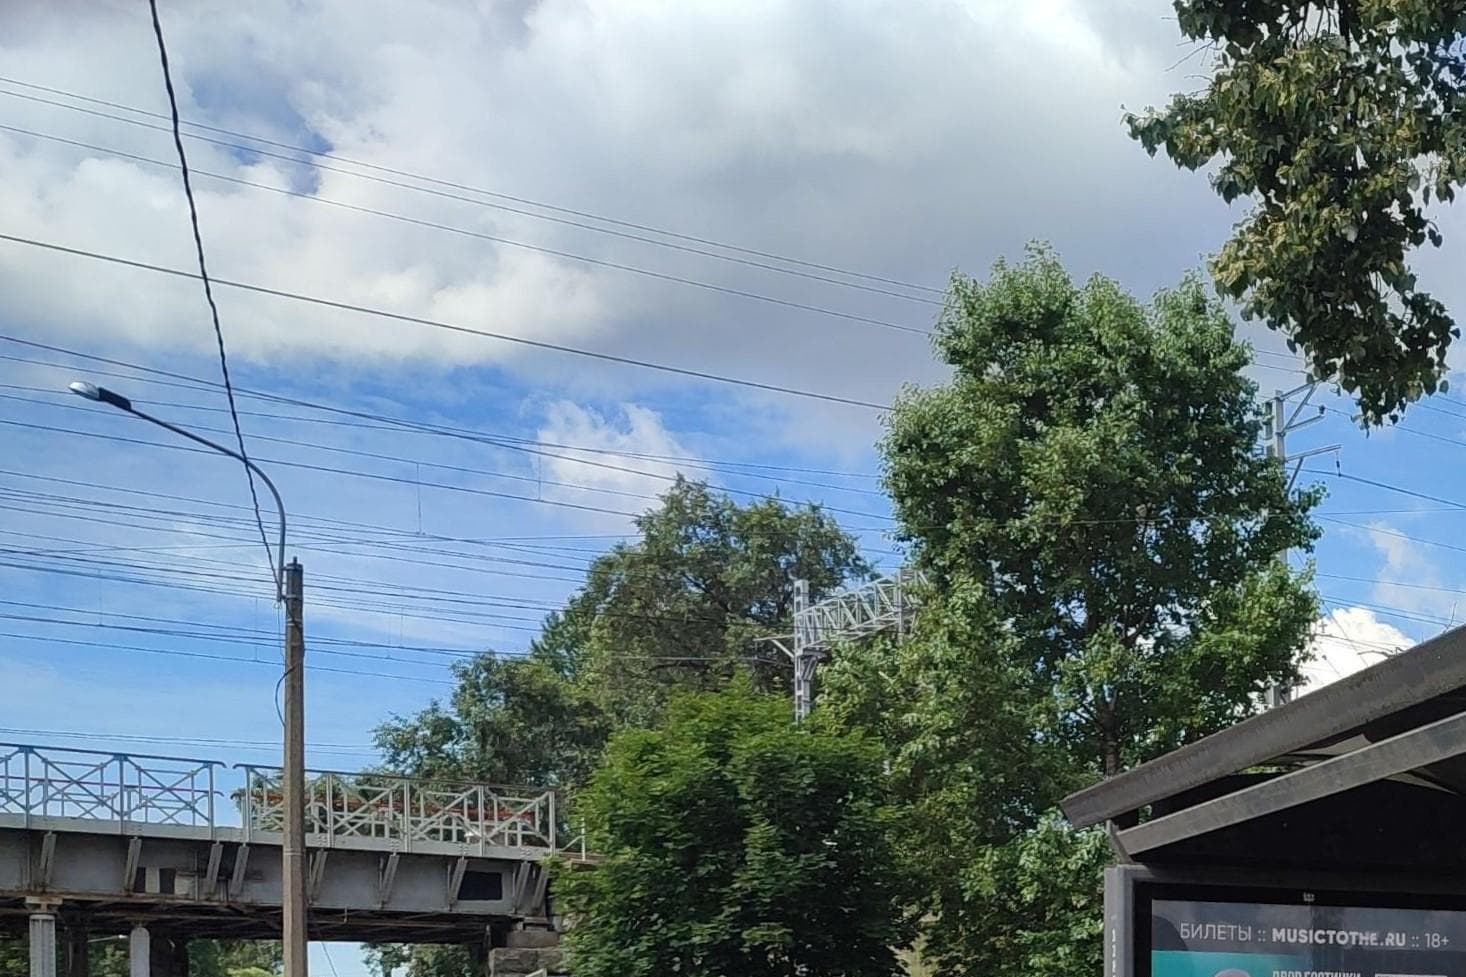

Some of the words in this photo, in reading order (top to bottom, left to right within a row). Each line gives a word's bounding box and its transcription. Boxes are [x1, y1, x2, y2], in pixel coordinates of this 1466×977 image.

[1180, 923, 1252, 941] БИЛЕТЫ
[1272, 928, 1406, 947] MUSICTOTHE.RU
[1425, 932, 1449, 949] 18+
